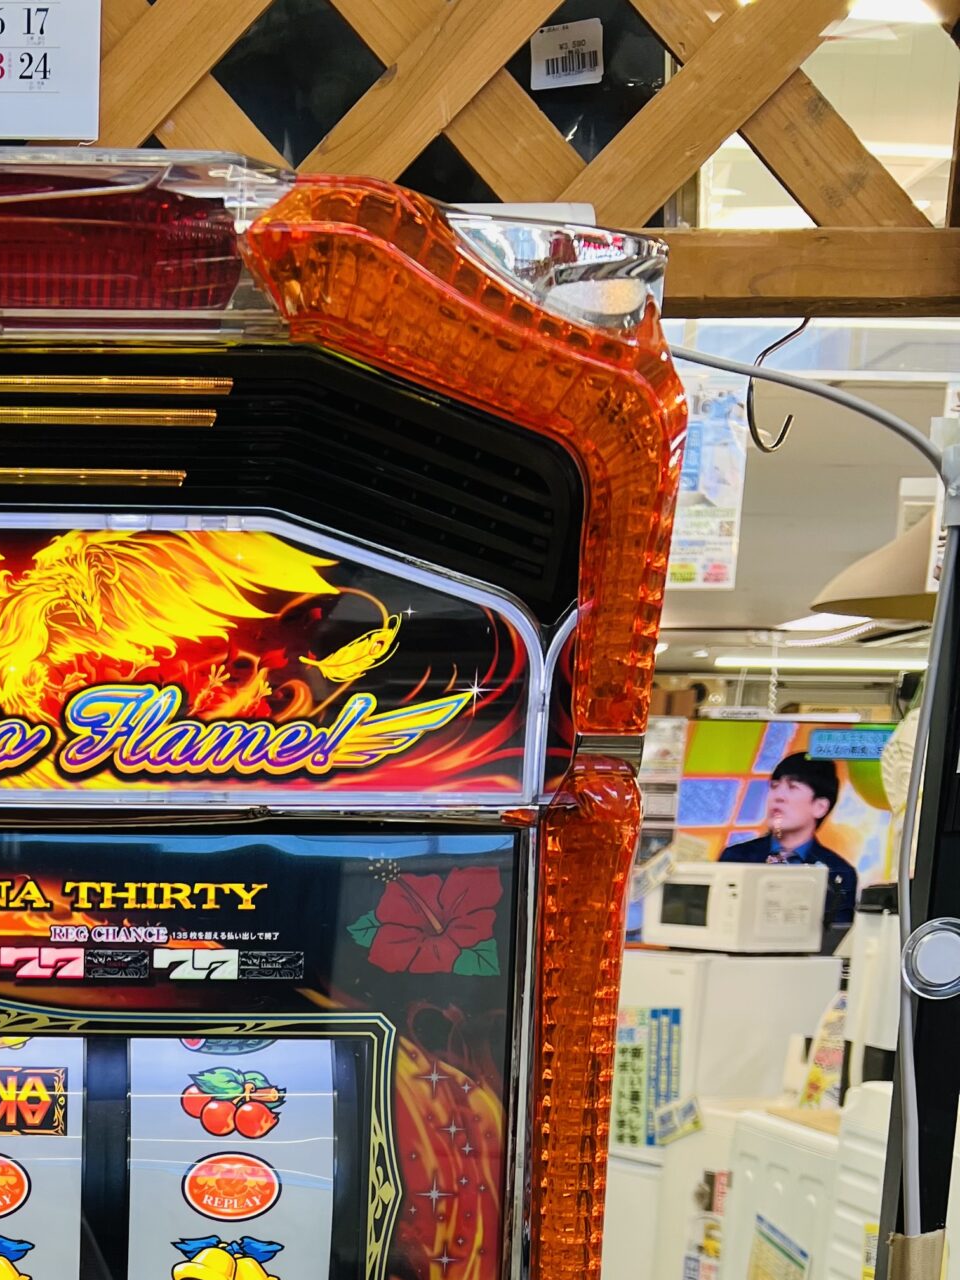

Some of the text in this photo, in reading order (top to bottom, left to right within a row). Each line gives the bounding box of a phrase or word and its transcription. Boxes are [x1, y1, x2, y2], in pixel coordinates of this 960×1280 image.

[21, 7, 49, 35] 17
[18, 51, 51, 80] 24
[61, 690, 363, 775] Flame!
[65, 881, 269, 911] THIRTY
[50, 925, 88, 942] REG
[91, 925, 168, 943] CHANCE
[202, 1193, 263, 1209] REPLAY
